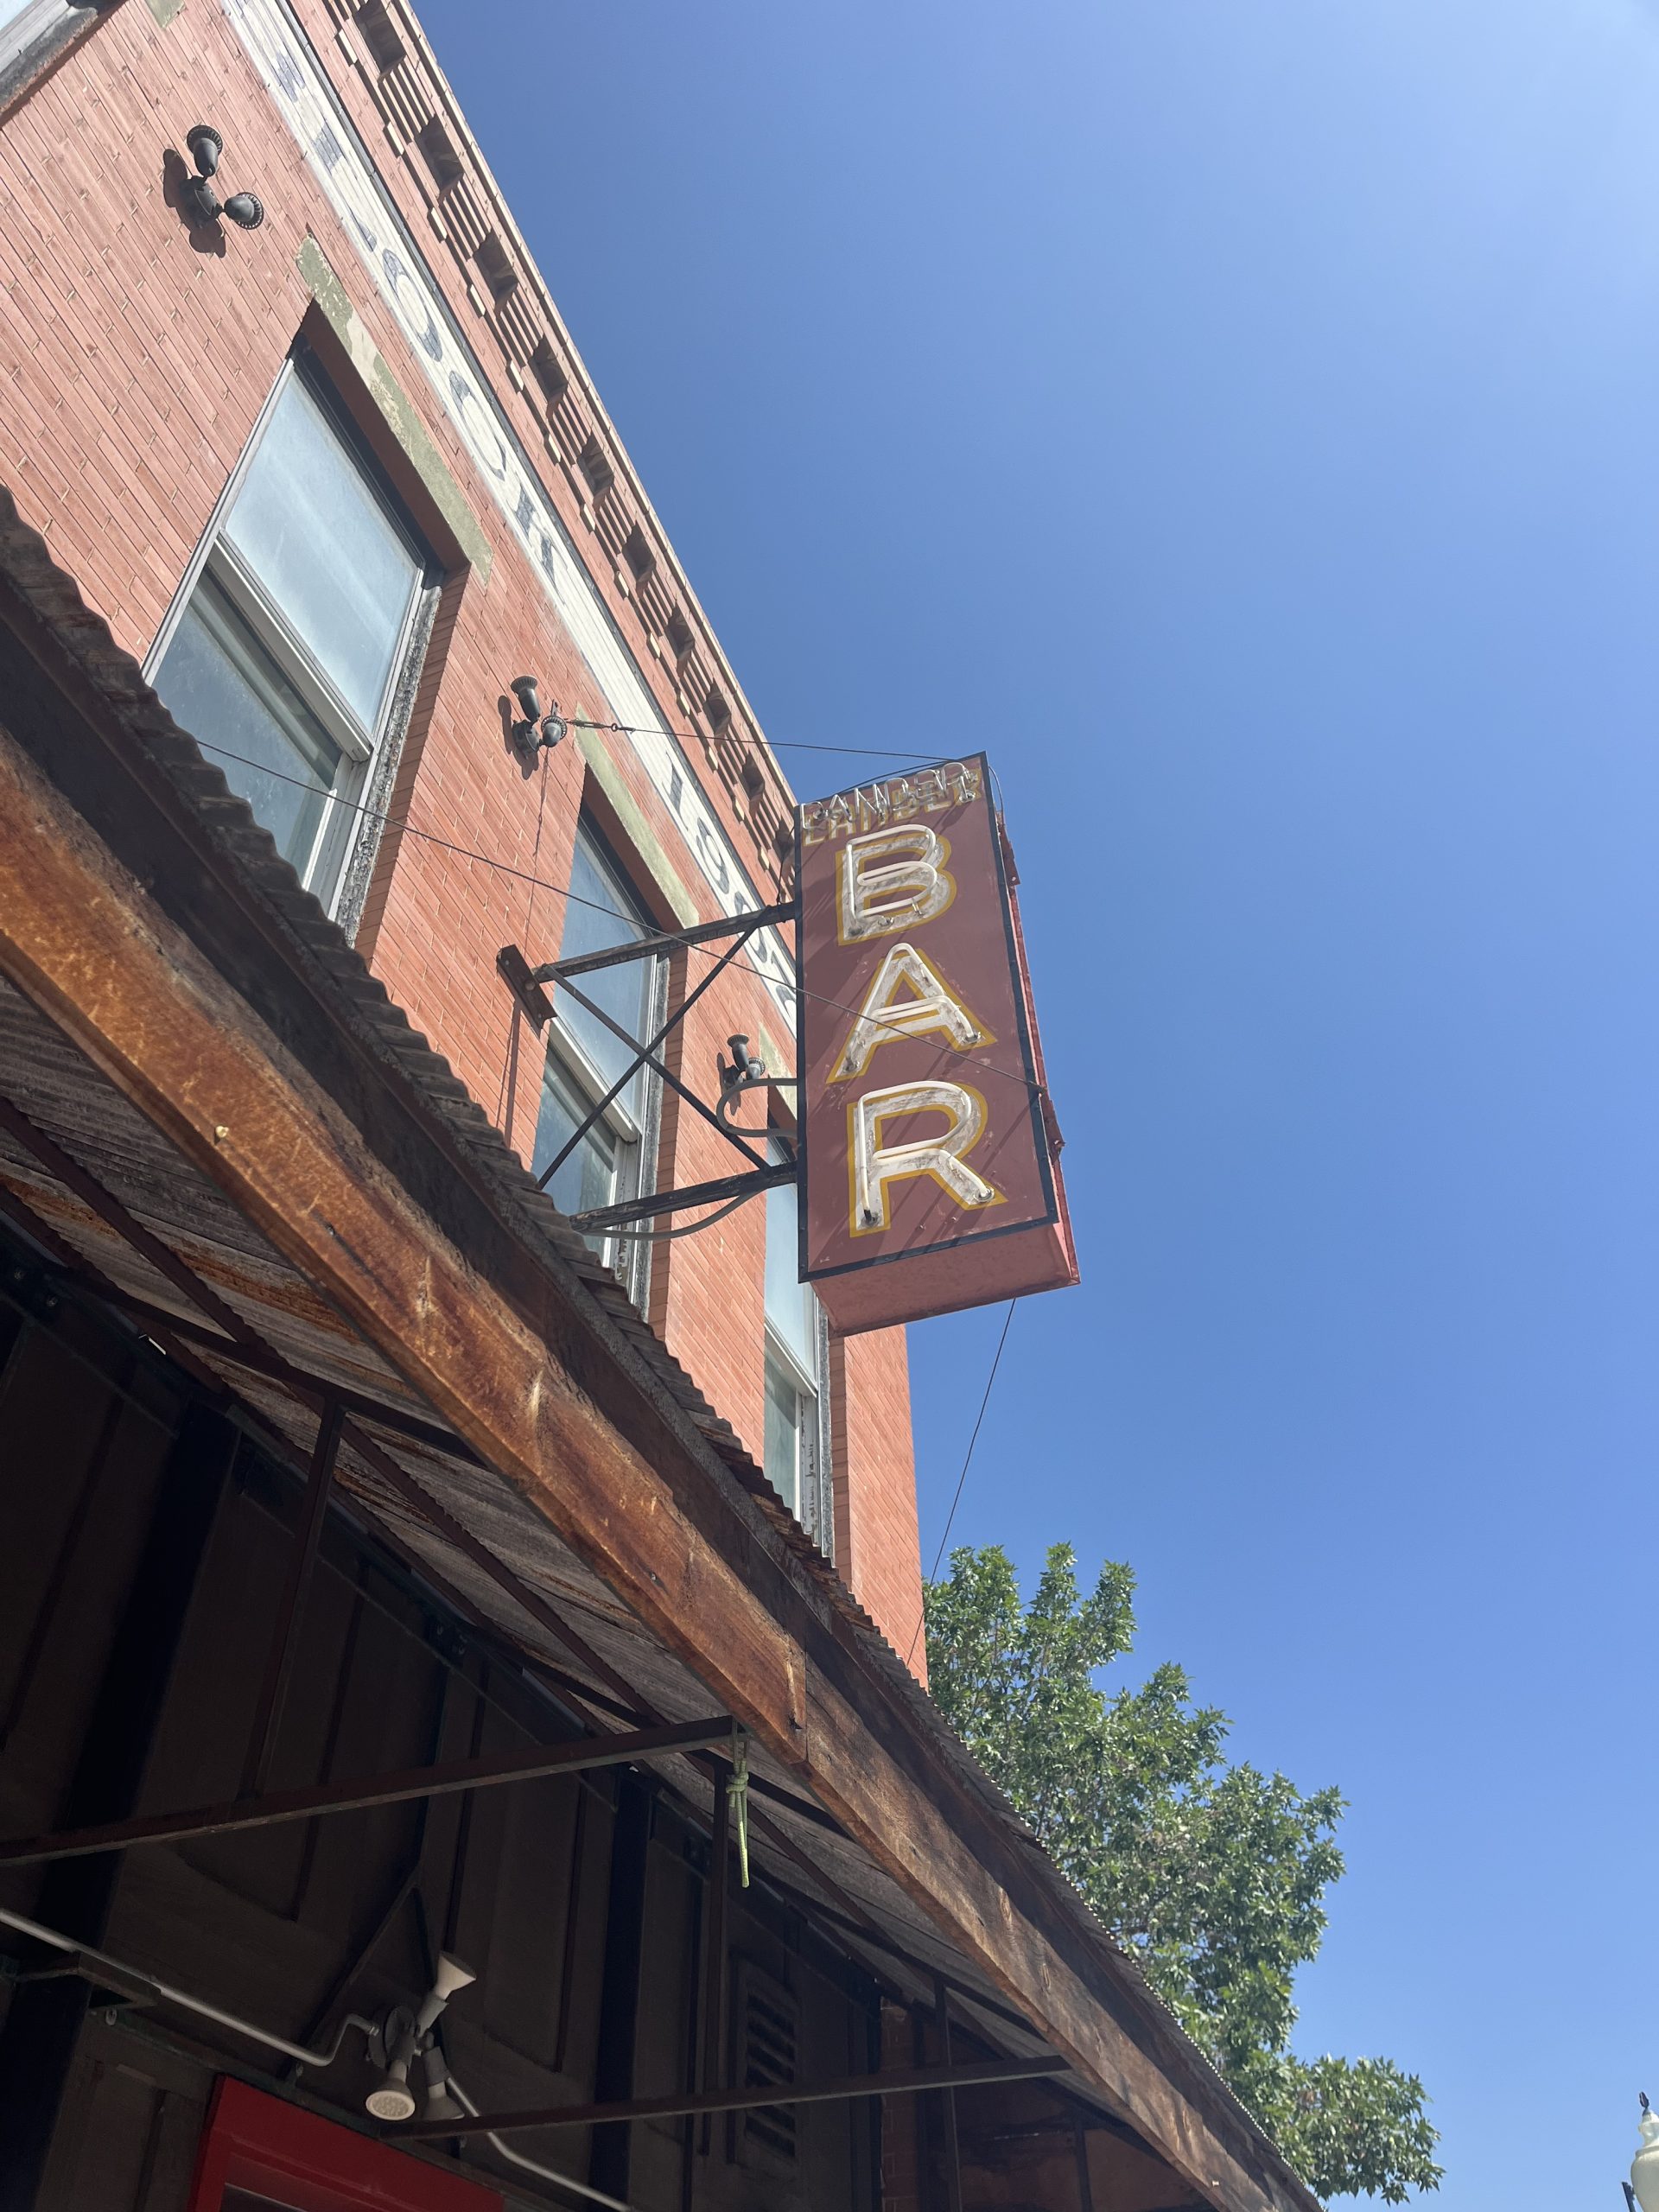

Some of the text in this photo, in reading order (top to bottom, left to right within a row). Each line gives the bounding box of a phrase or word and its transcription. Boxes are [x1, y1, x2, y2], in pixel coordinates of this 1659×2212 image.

[666, 750, 796, 1020] 1907
[799, 761, 982, 846] LANDER
[825, 823, 1007, 1237] BAR
